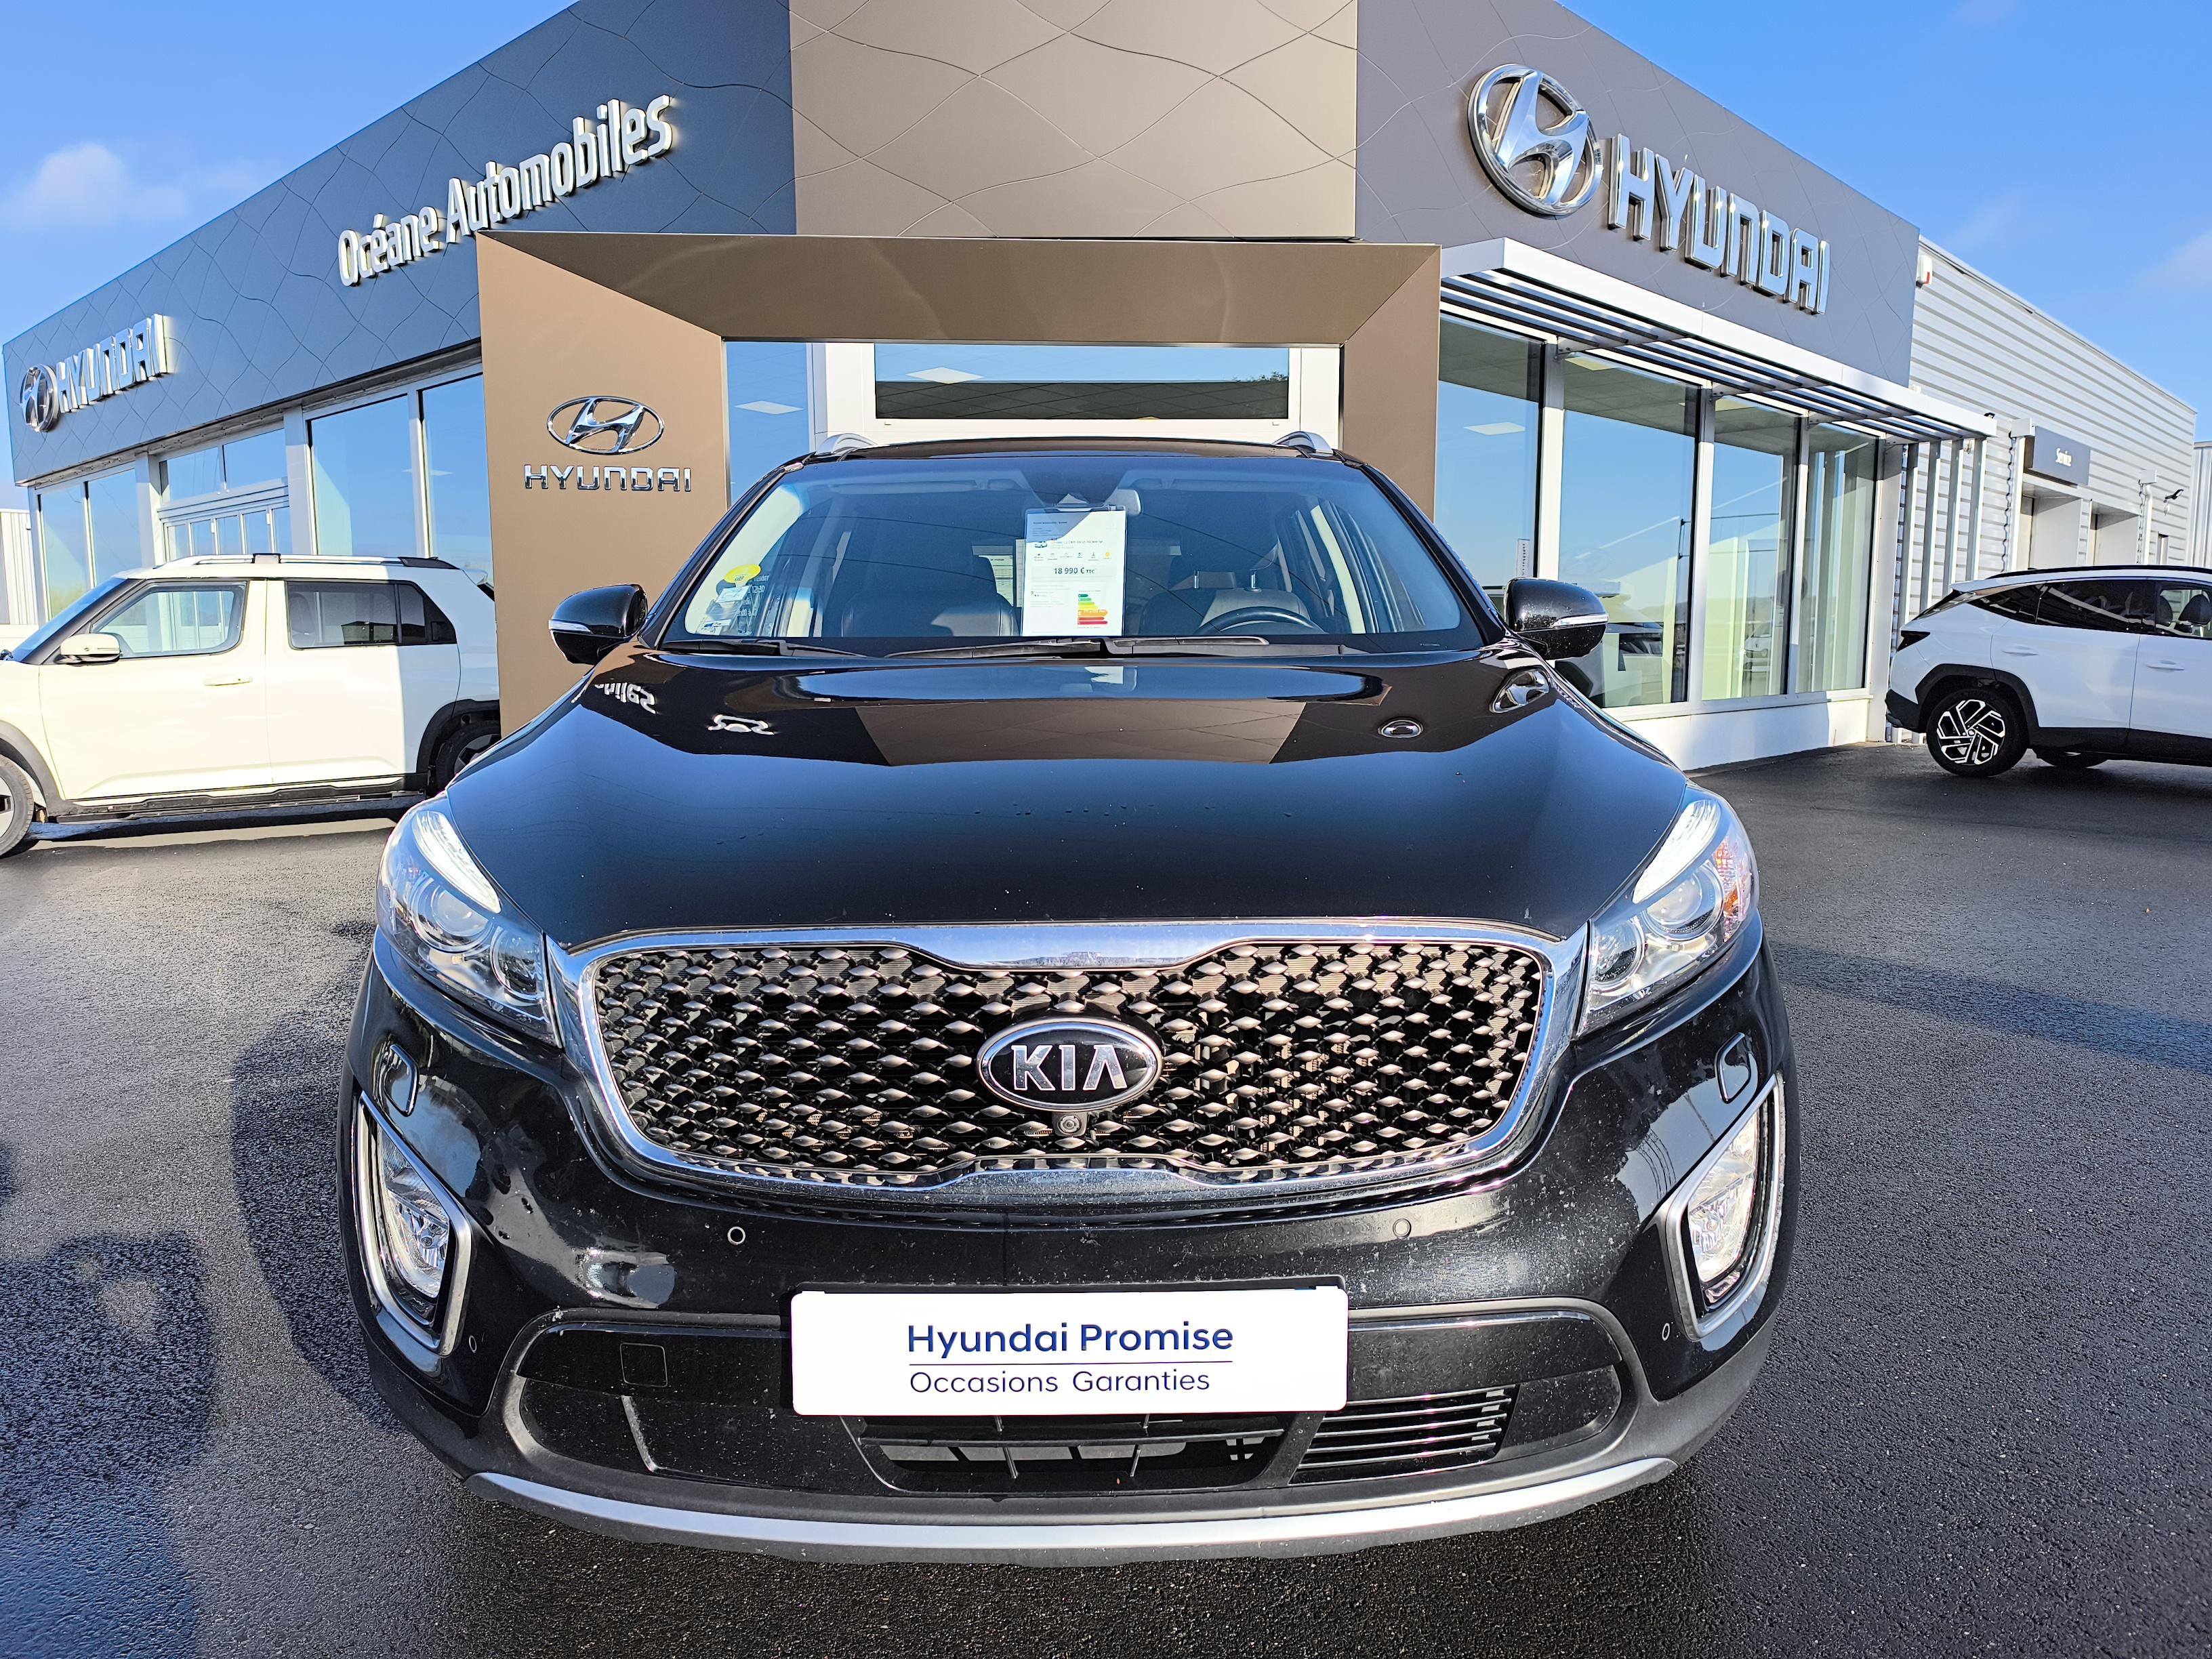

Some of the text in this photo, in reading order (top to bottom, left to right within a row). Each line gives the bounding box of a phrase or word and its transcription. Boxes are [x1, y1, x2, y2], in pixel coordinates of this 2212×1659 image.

[337, 94, 674, 287] Océane Automobiles
[1607, 132, 1831, 315] HYUNDAI
[56, 313, 168, 413] HYUNDAI
[524, 464, 692, 492] HYUNDAI
[1010, 1044, 1128, 1091] KIA
[907, 1321, 1233, 1359] Hyundai Promise
[909, 1369, 1210, 1393] Occasions Garanties
